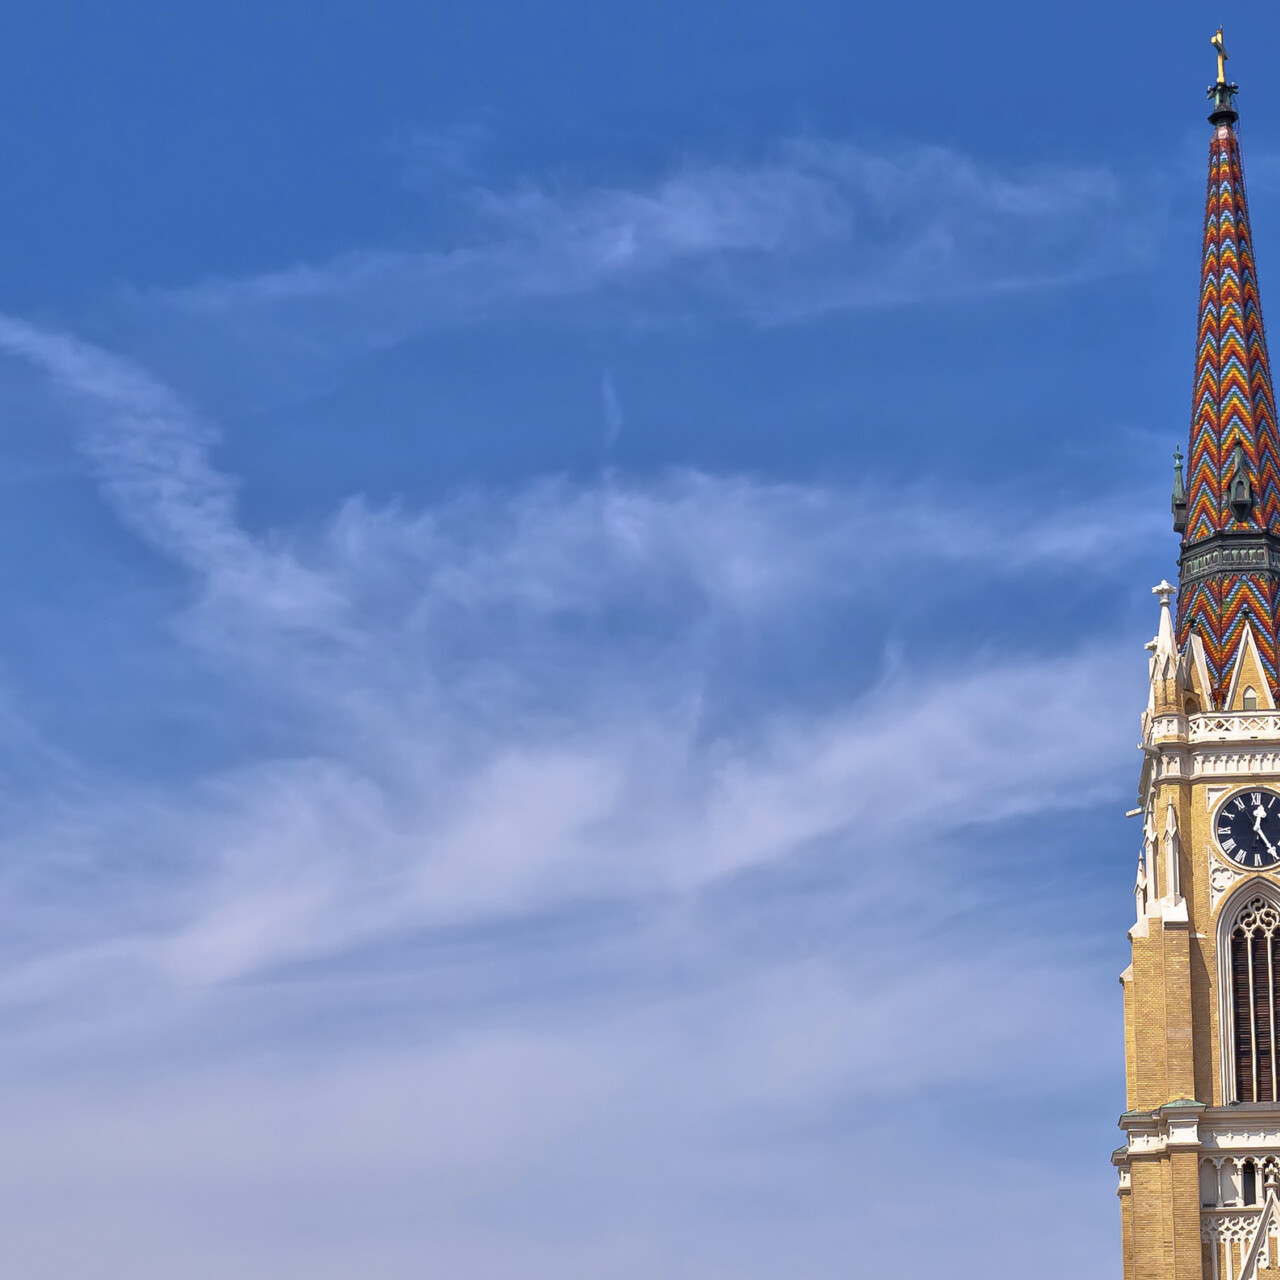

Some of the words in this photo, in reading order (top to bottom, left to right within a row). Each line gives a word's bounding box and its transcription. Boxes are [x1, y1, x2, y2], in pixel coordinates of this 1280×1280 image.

[1233, 797, 1245, 811] XI
[1251, 793, 1261, 805] XII
[1268, 797, 1275, 808] I
[1222, 810, 1235, 820] X
[1218, 826, 1231, 834] IX
[1234, 849, 1247, 864] VII
[1254, 854, 1262, 866] VI
